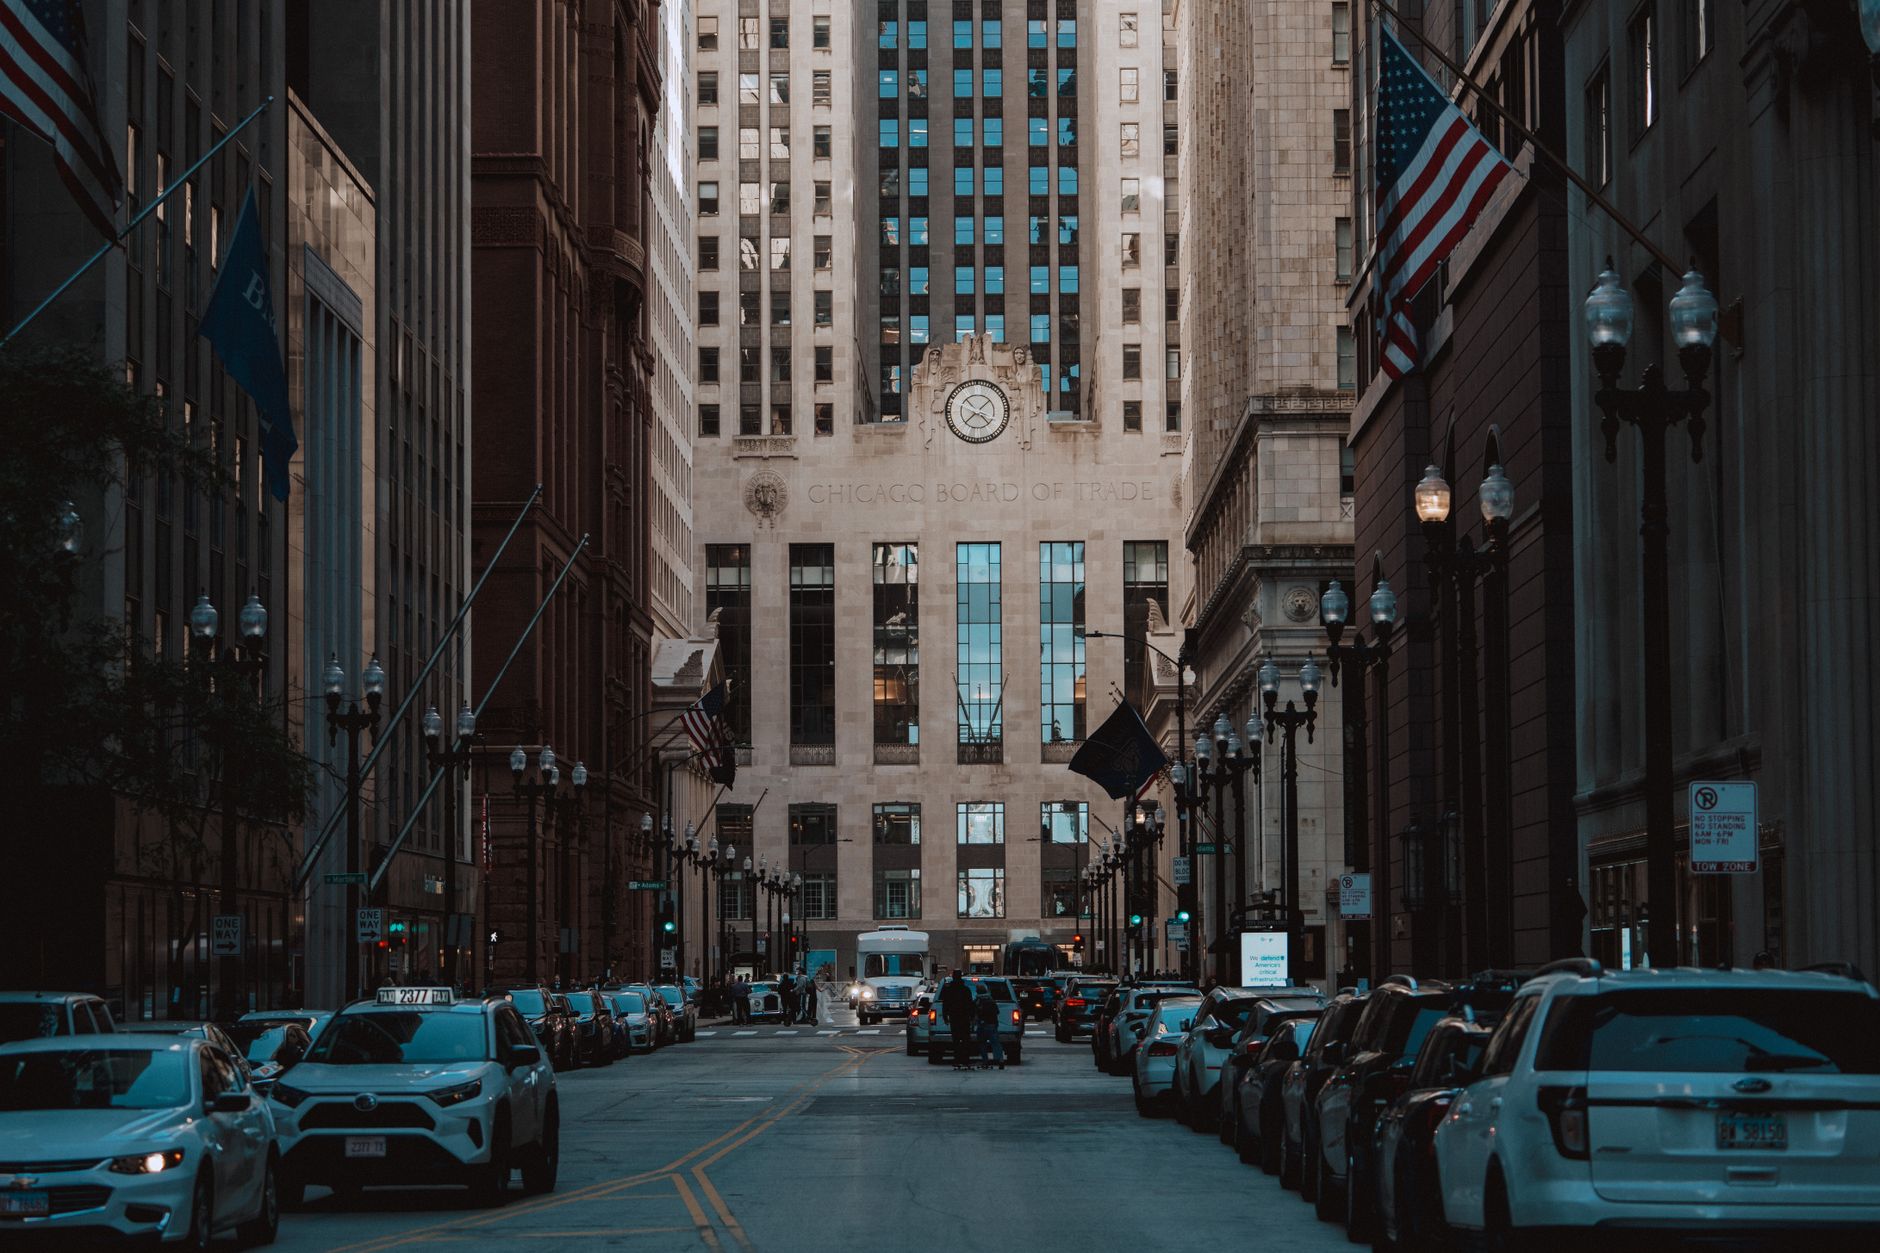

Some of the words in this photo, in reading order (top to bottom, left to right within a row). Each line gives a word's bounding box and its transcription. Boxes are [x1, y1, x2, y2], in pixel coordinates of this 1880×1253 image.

[807, 484, 925, 504] CHICAGO
[936, 483, 1019, 503] BOARD
[1031, 482, 1064, 501] OF
[1073, 481, 1153, 501] TRADE
[1696, 862, 1717, 871] TOW
[1723, 862, 1751, 871] ZONE
[359, 910, 379, 920] ONE
[215, 918, 239, 929] ONE
[359, 920, 380, 929] WAY
[215, 929, 240, 940] WAY
[379, 990, 395, 1003] TAXI
[400, 989, 429, 1003] 2377
[433, 990, 448, 1003] TAXI
